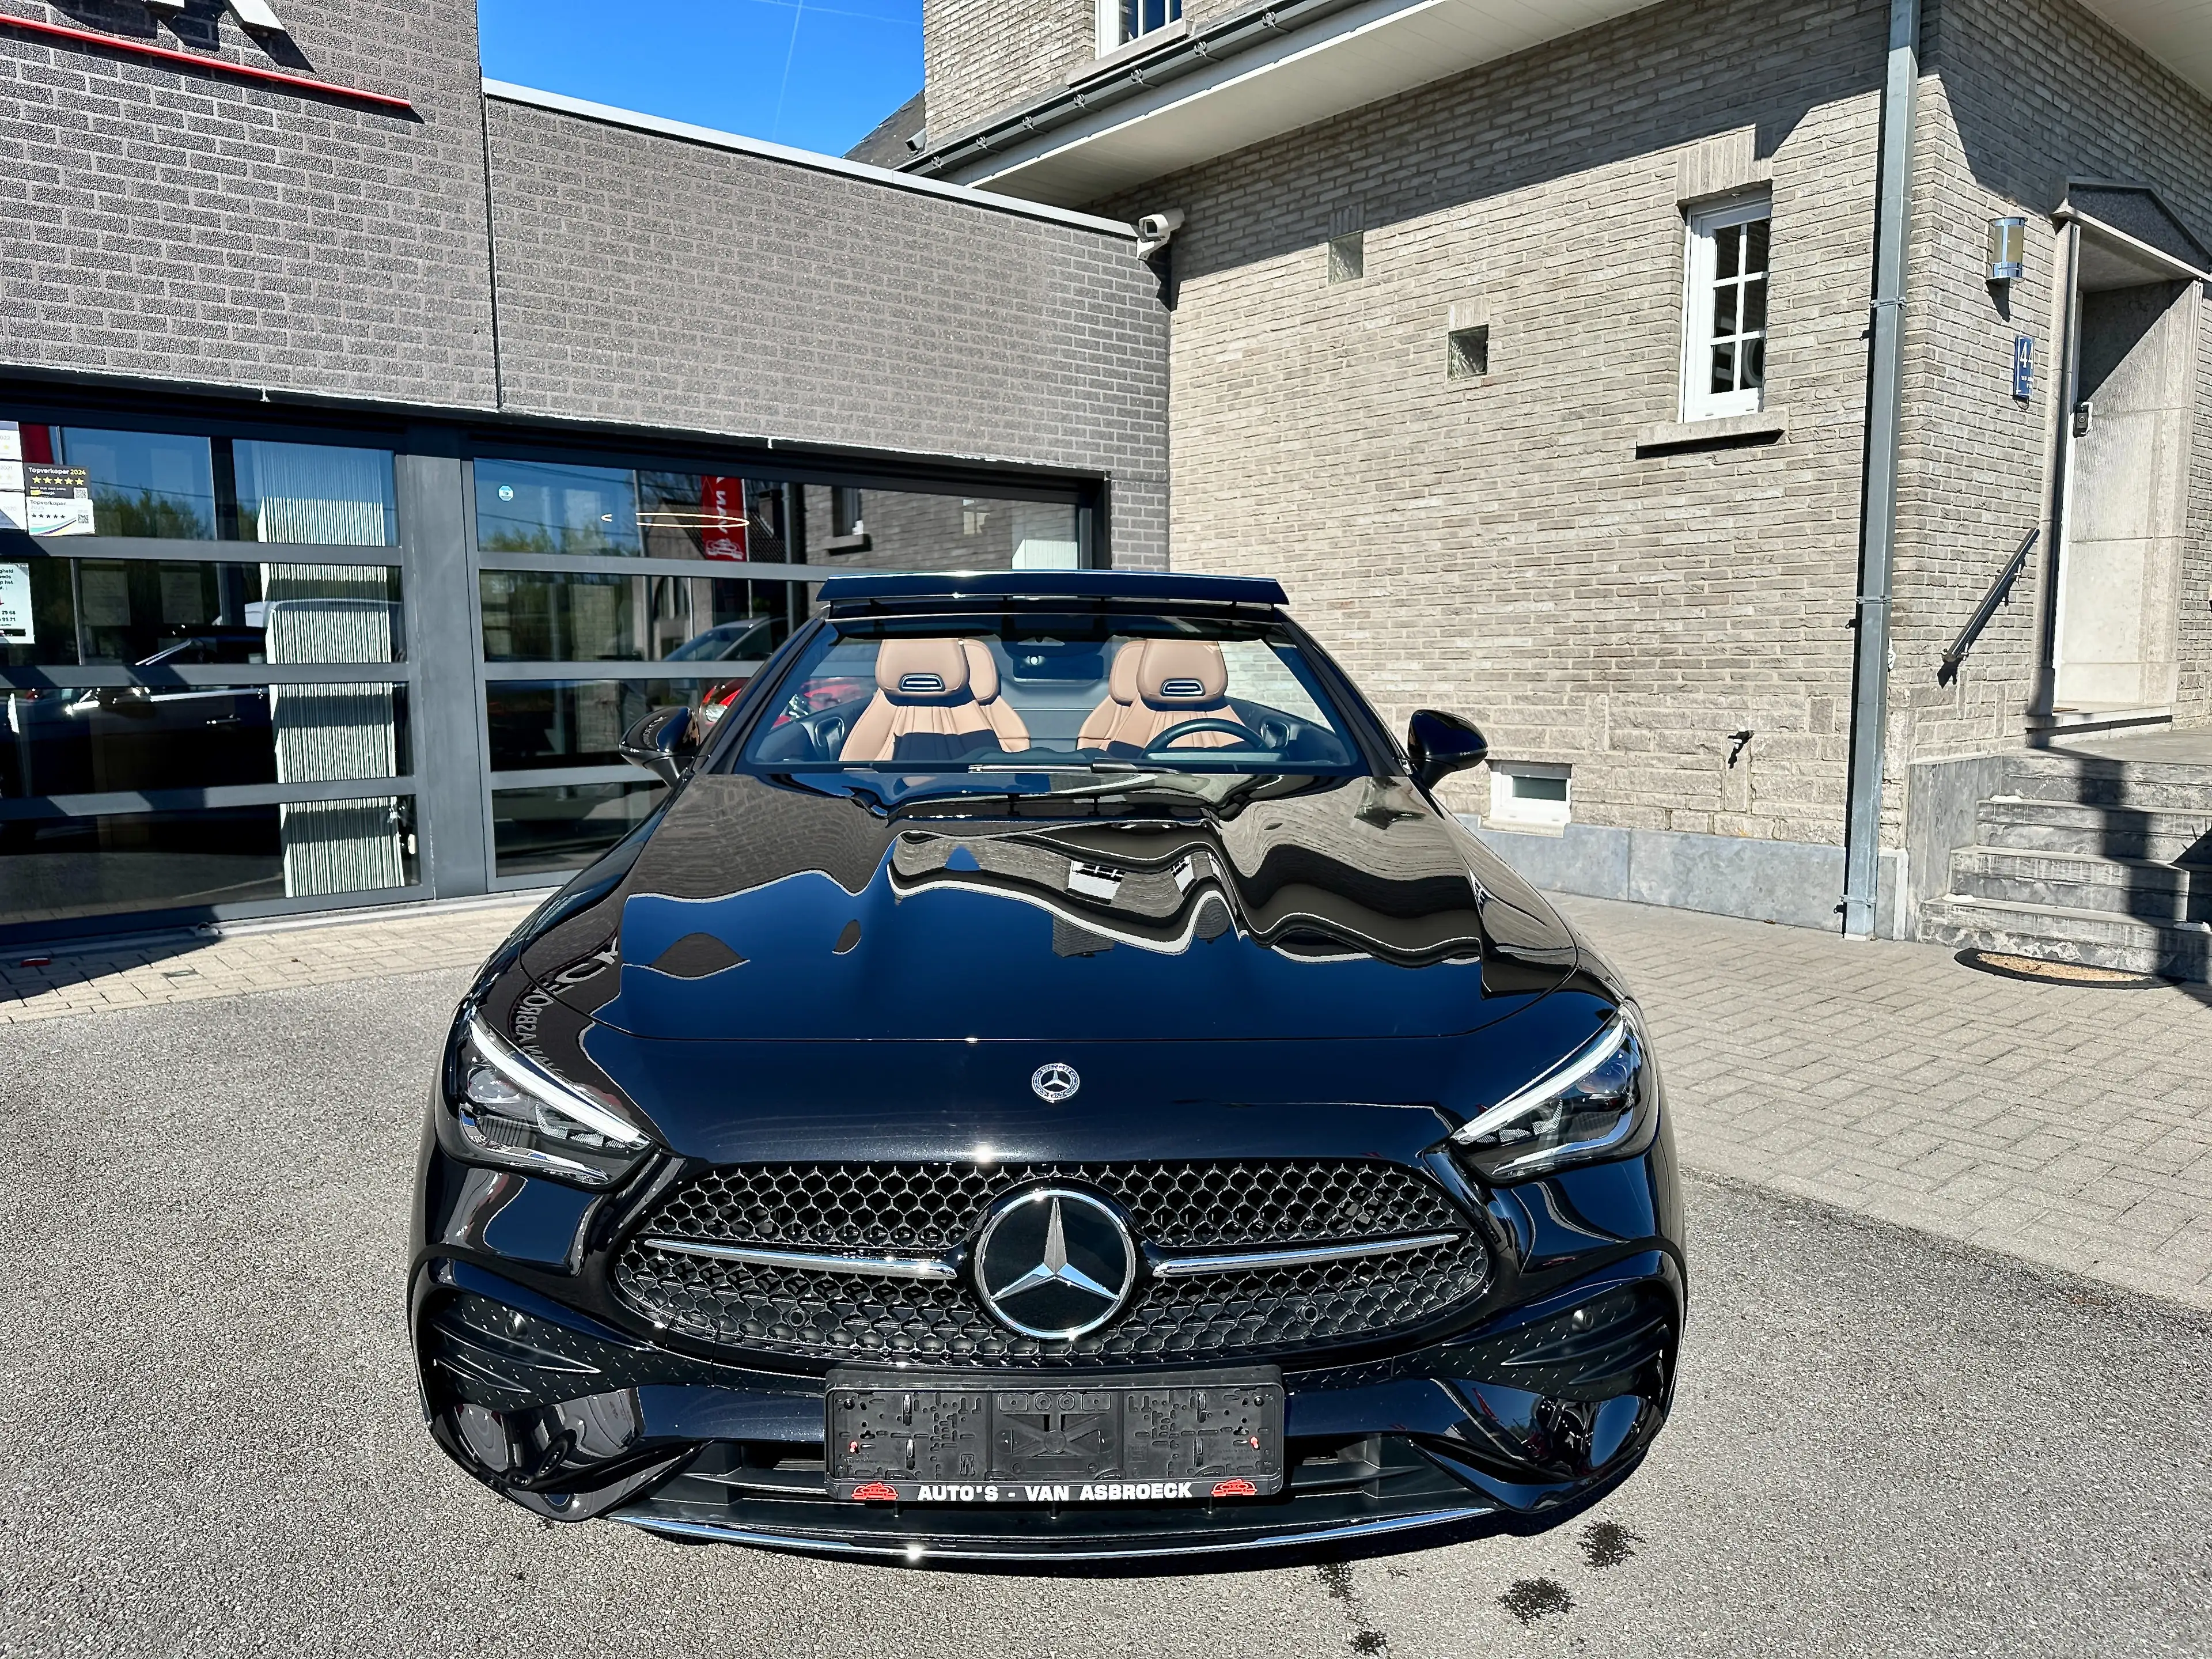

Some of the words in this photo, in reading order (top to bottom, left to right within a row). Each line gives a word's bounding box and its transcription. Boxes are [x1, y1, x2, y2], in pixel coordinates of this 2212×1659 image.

[2020, 341, 2034, 370] 44
[28, 467, 69, 475] Topverkoper
[918, 1484, 999, 1502] AUTO'S
[1024, 1484, 1070, 1502] VAN
[1078, 1482, 1193, 1501] ASBROECK
